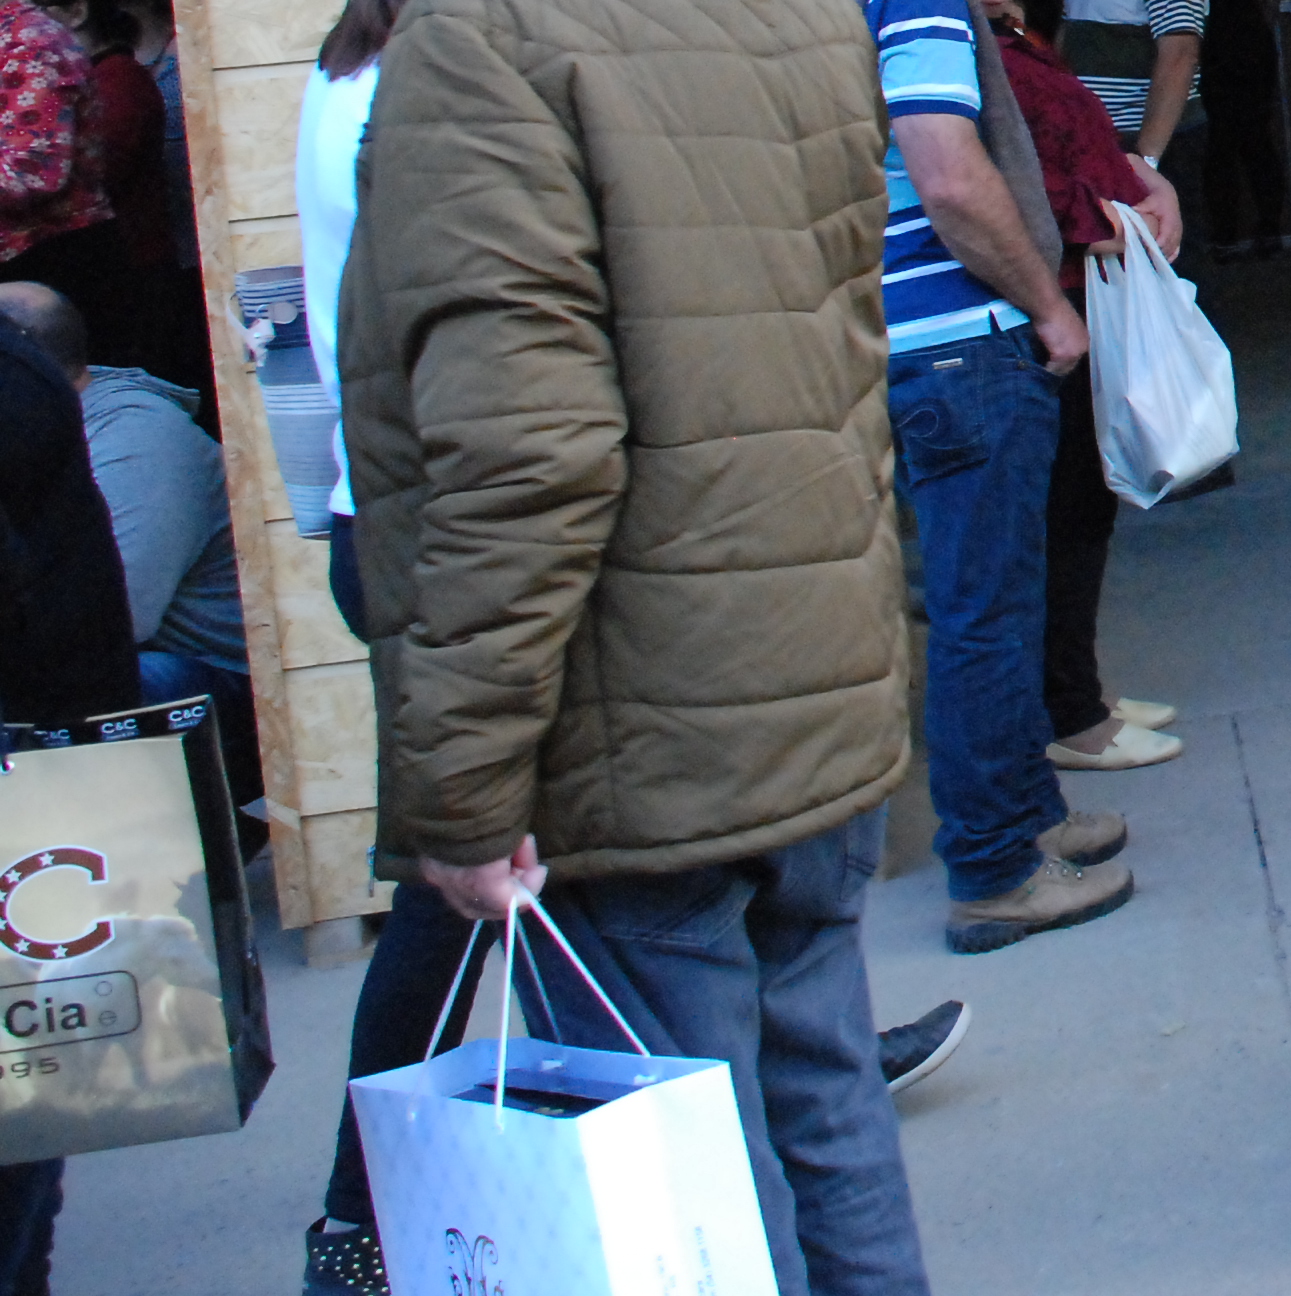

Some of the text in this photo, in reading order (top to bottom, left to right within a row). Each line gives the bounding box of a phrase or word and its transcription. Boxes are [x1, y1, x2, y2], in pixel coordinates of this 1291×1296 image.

[168, 705, 206, 722] C&C
[100, 718, 138, 734] C&C
[4, 996, 88, 1038] Cia
